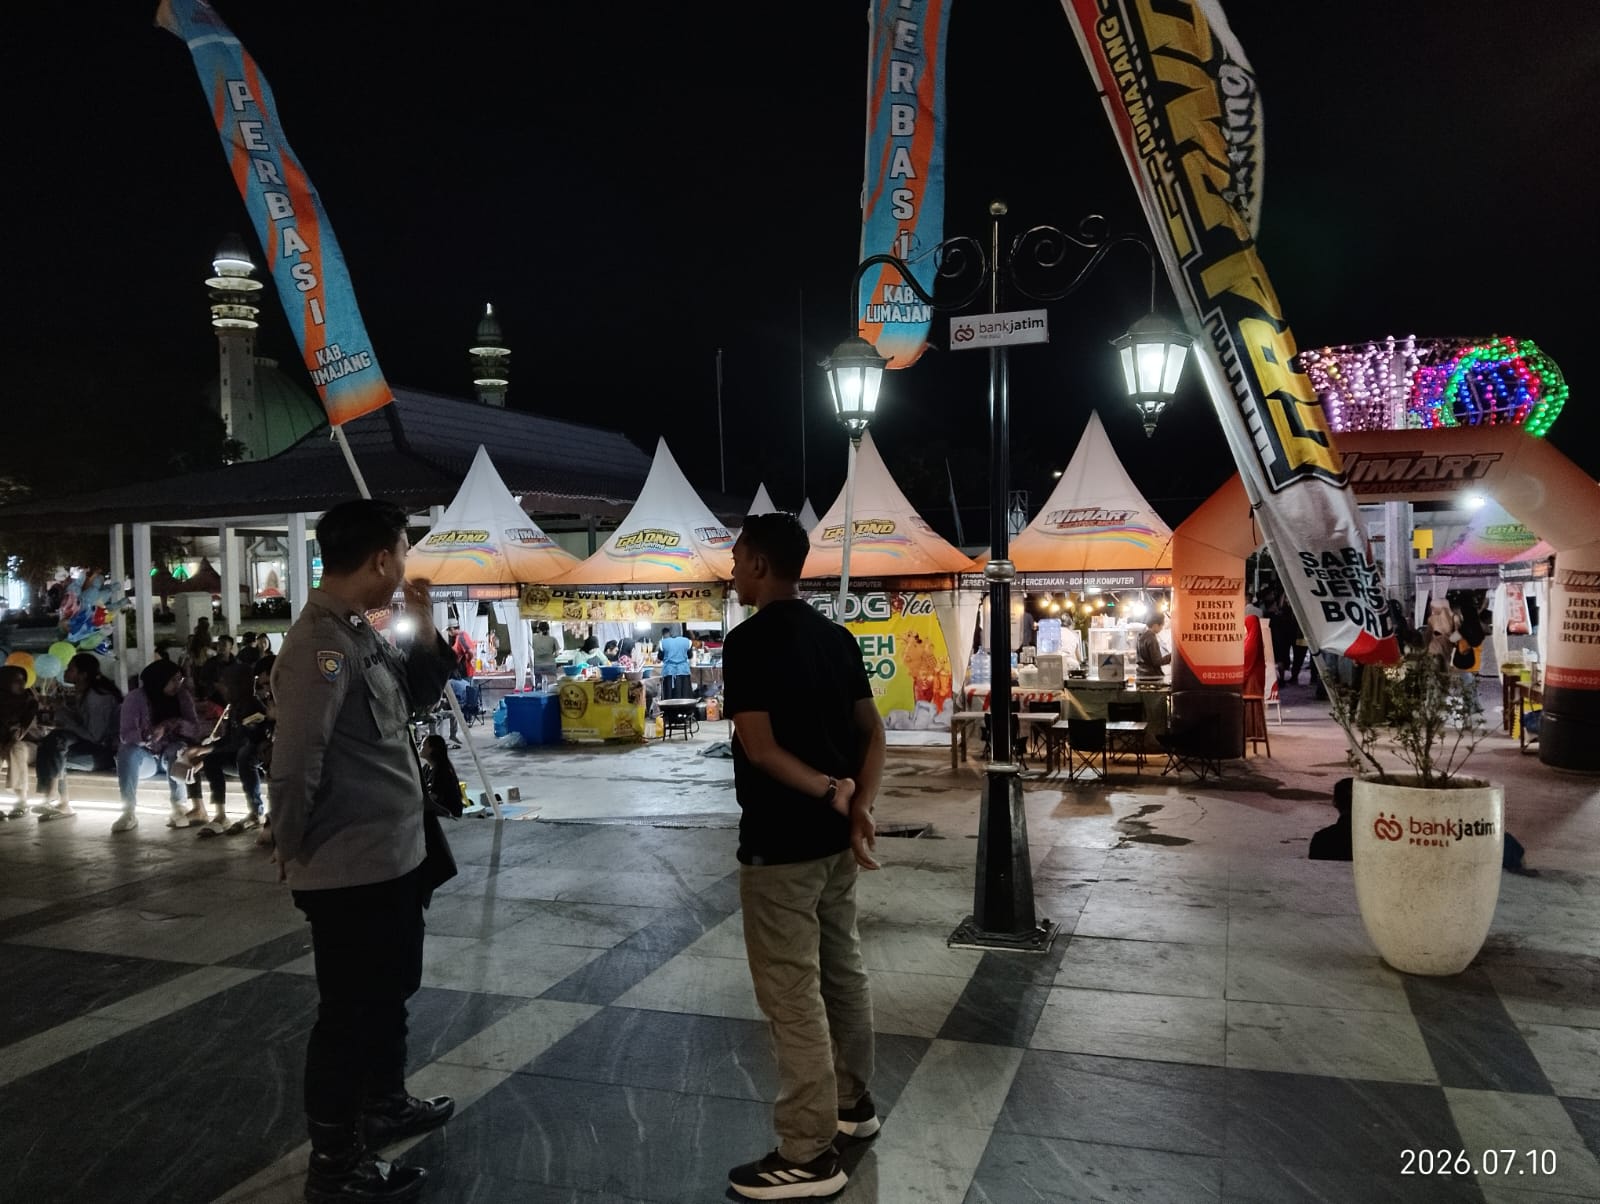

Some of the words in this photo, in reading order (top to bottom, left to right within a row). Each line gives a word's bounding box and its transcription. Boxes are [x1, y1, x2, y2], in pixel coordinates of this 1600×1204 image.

[1099, 15, 1156, 156] LUMAJANG
[890, 0, 919, 261] ERBASI
[226, 79, 325, 327] PERBASI
[865, 304, 933, 323] LUMAJAN
[979, 317, 1045, 335] bankjatim
[315, 343, 346, 366] KAB.
[310, 351, 372, 386] UMAJANG
[1298, 547, 1376, 572] SABL
[1096, 576, 1135, 585] KOMPUTER
[1196, 600, 1235, 610] JERSEY
[1310, 579, 1385, 610] JERS
[1193, 611, 1236, 621] SABLON
[1192, 622, 1237, 632] BORDIR
[1563, 621, 1600, 633] BORD
[859, 635, 894, 656] EH
[1409, 815, 1496, 841] bankjatim
[1409, 838, 1449, 847] PEDULI
